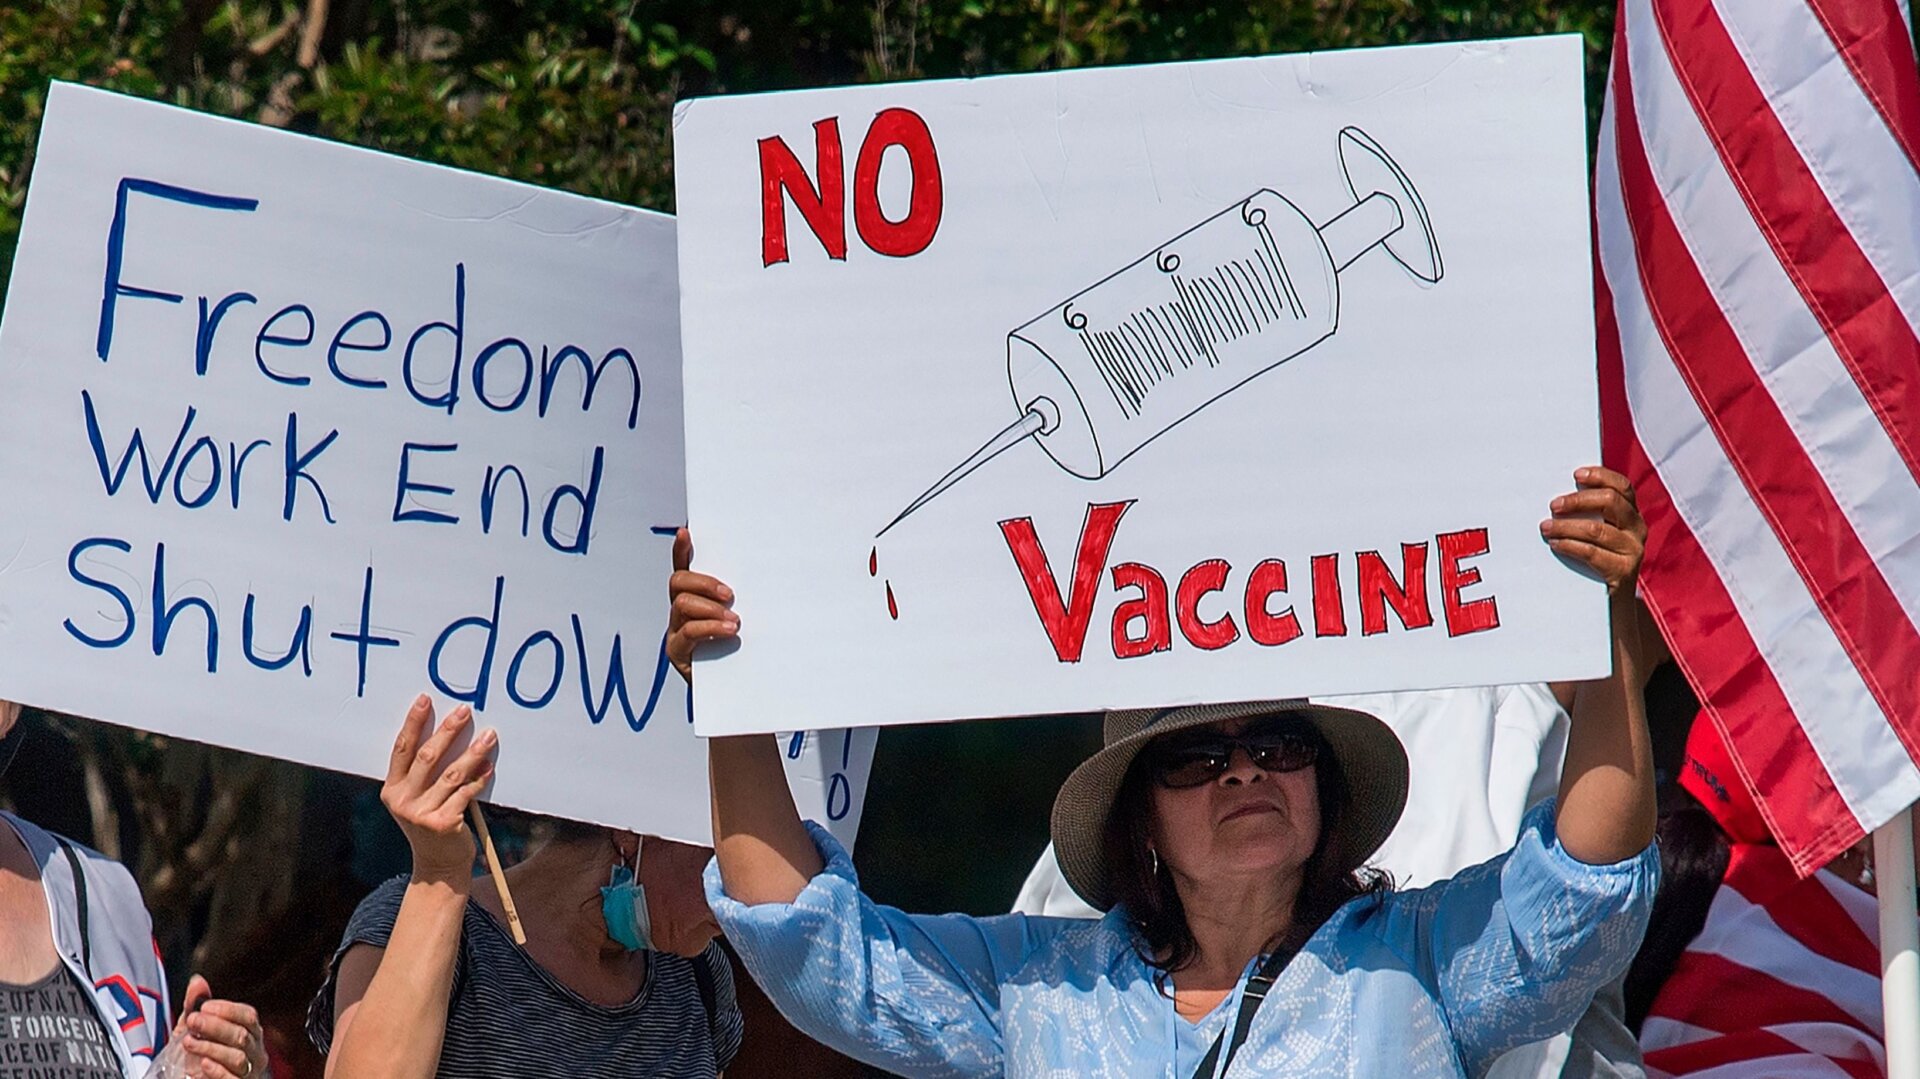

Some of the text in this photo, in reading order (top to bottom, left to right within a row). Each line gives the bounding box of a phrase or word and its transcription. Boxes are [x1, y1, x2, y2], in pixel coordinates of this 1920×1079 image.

[758, 107, 943, 268] NO
[97, 178, 641, 429] Freedom
[83, 391, 604, 555] Work End
[64, 537, 693, 733] Shutdow
